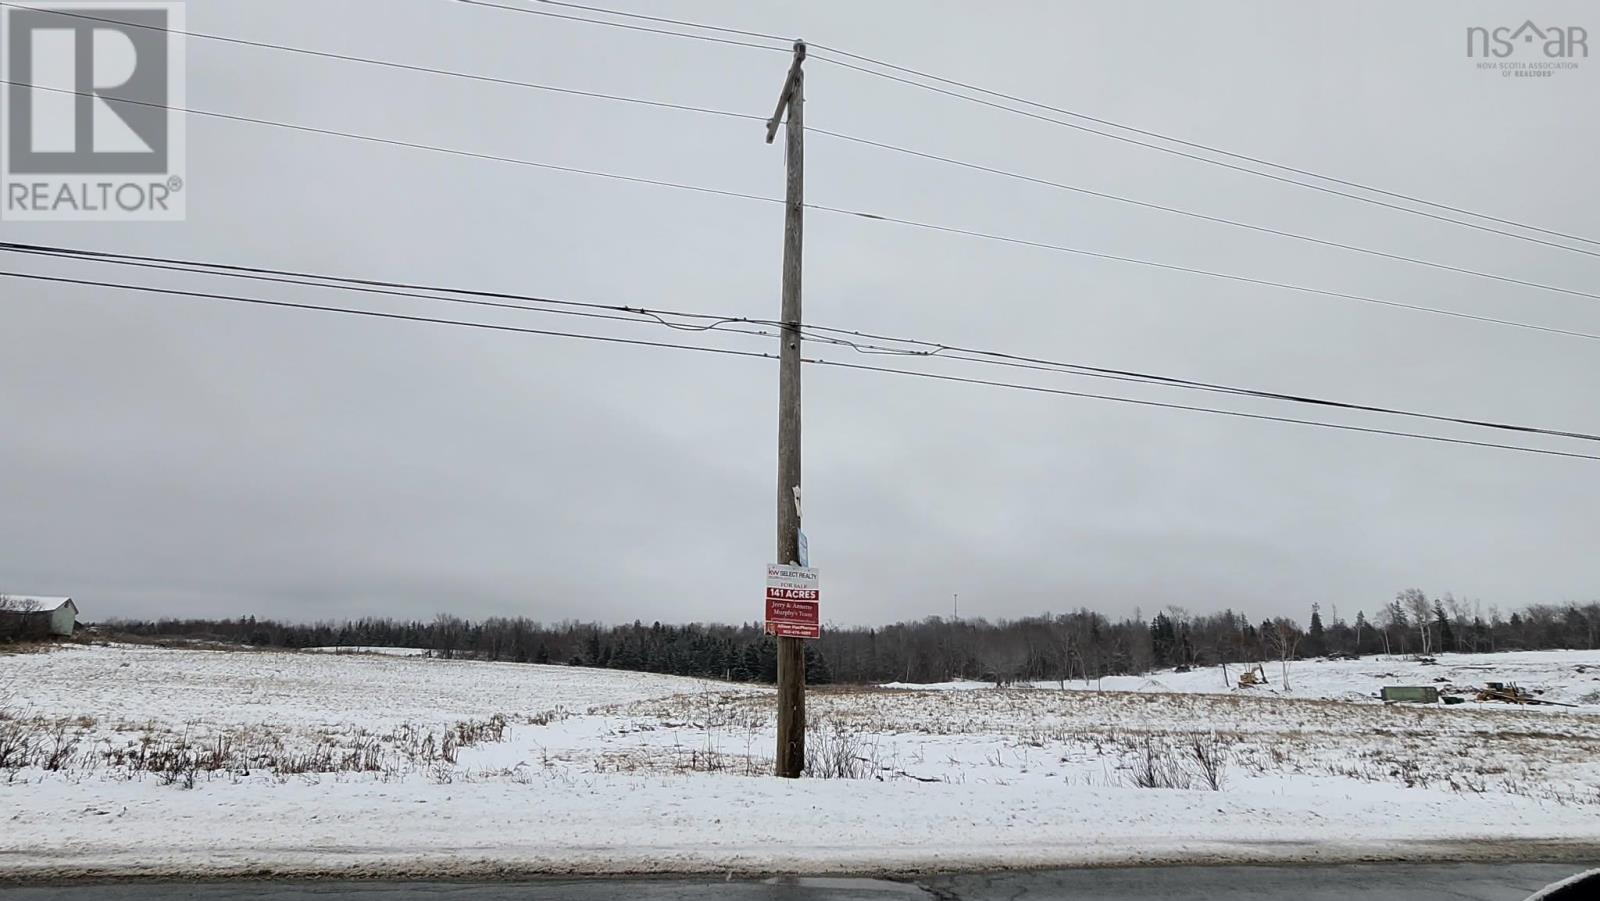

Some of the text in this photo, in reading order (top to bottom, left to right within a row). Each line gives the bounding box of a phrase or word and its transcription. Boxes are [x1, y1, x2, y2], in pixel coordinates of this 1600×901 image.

[770, 588, 816, 599] 141 ACRES
[774, 609, 797, 617] Murphy's
